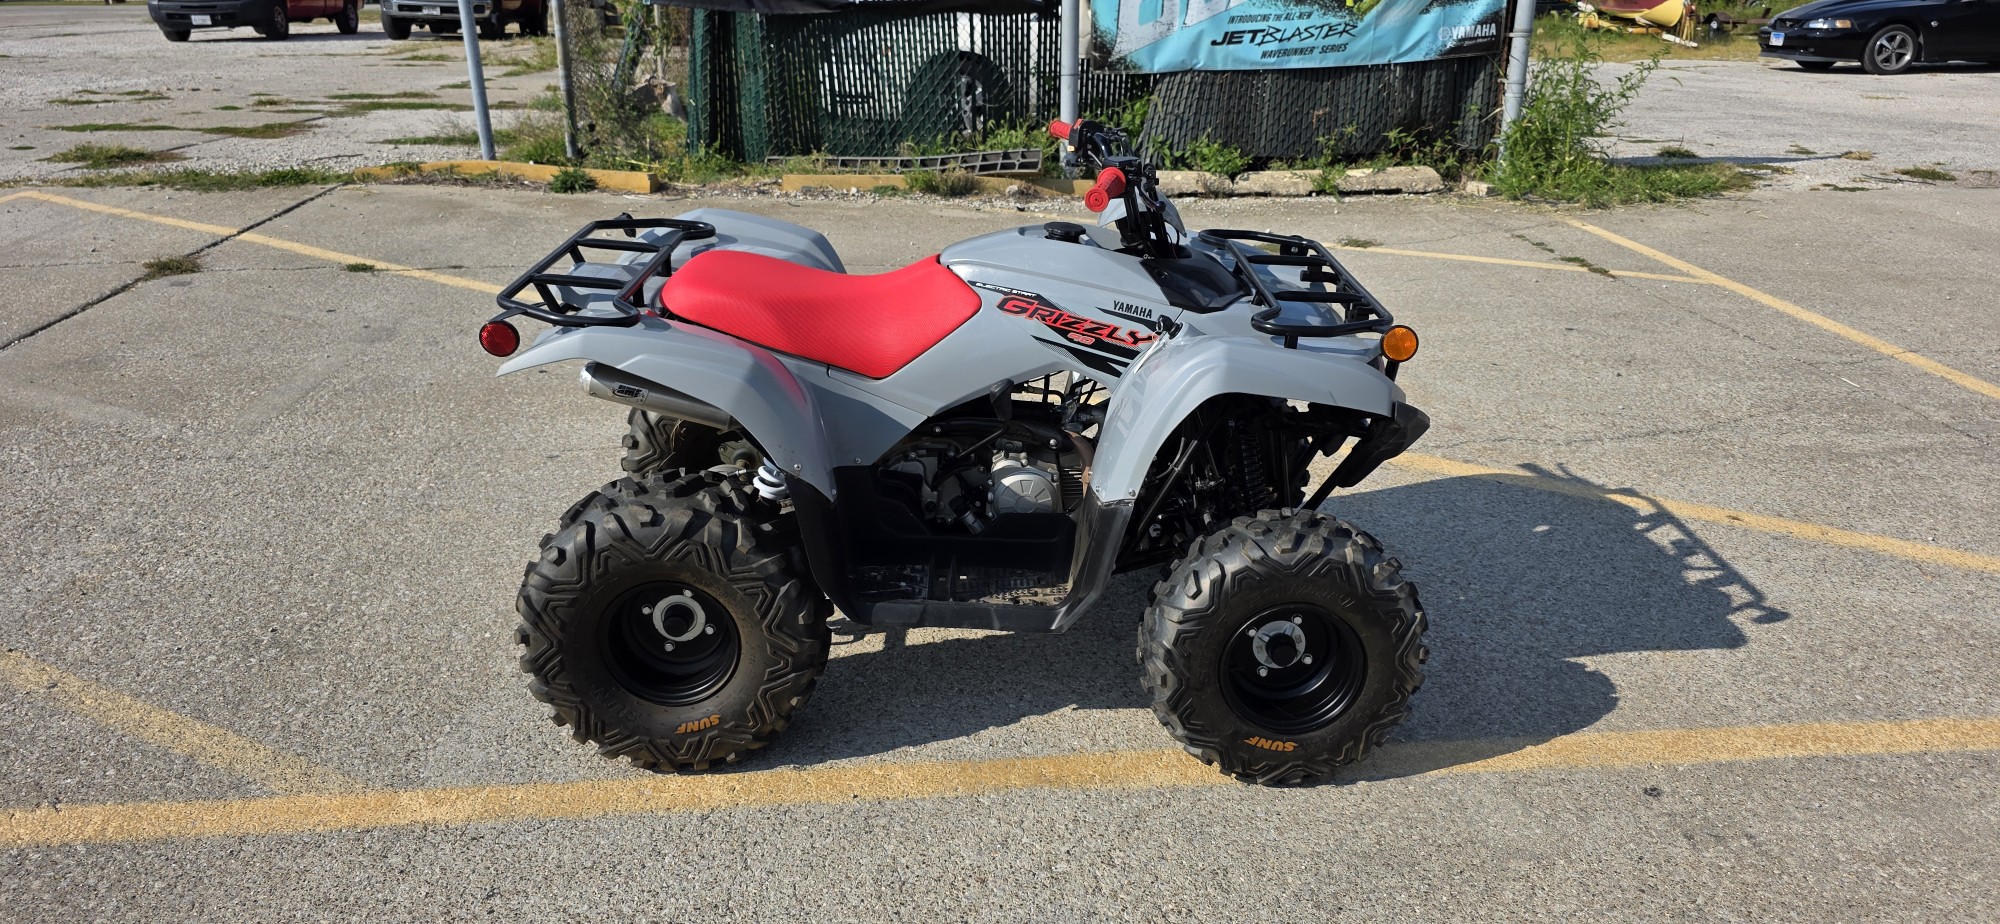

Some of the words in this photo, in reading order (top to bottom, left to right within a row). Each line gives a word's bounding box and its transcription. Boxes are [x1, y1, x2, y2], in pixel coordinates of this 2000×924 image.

[1228, 13, 1272, 25] INTRODUCING
[1272, 13, 1284, 23] THE
[1284, 11, 1315, 21] ALL-NEW
[1452, 23, 1496, 40] YAMAHA
[1319, 43, 1348, 54] SERIES
[975, 282, 1011, 293] ELECTRIC
[1011, 289, 1037, 297] START
[1113, 300, 1152, 319] YAMAHA
[996, 295, 1158, 347] GRIZZLY
[1067, 332, 1095, 345] 90
[674, 714, 721, 735] SUNF
[1243, 735, 1299, 752] SUNF
